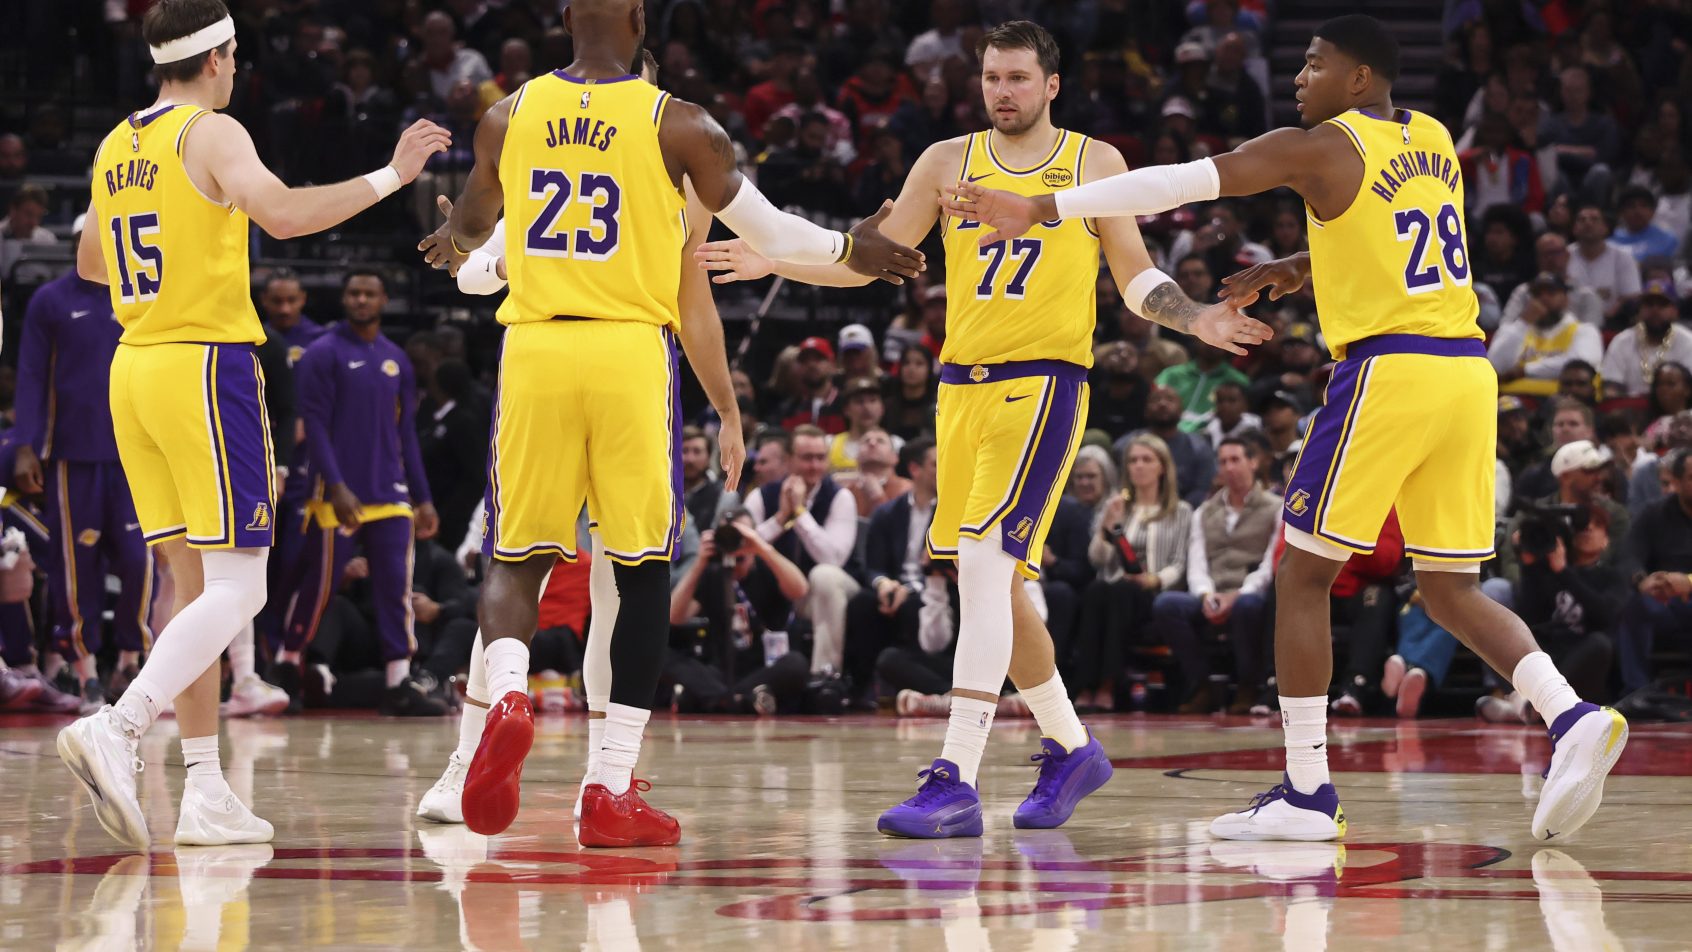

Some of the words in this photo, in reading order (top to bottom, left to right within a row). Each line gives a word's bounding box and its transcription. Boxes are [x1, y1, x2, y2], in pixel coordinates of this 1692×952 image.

[545, 117, 617, 151] JAMES
[105, 159, 158, 197] REAVES
[1044, 172, 1071, 182] bibigo
[1371, 150, 1460, 203] HACHIMURA
[525, 168, 622, 262] 23
[110, 211, 163, 304] 15
[975, 237, 1044, 300] 77
[1392, 202, 1473, 296] 28
